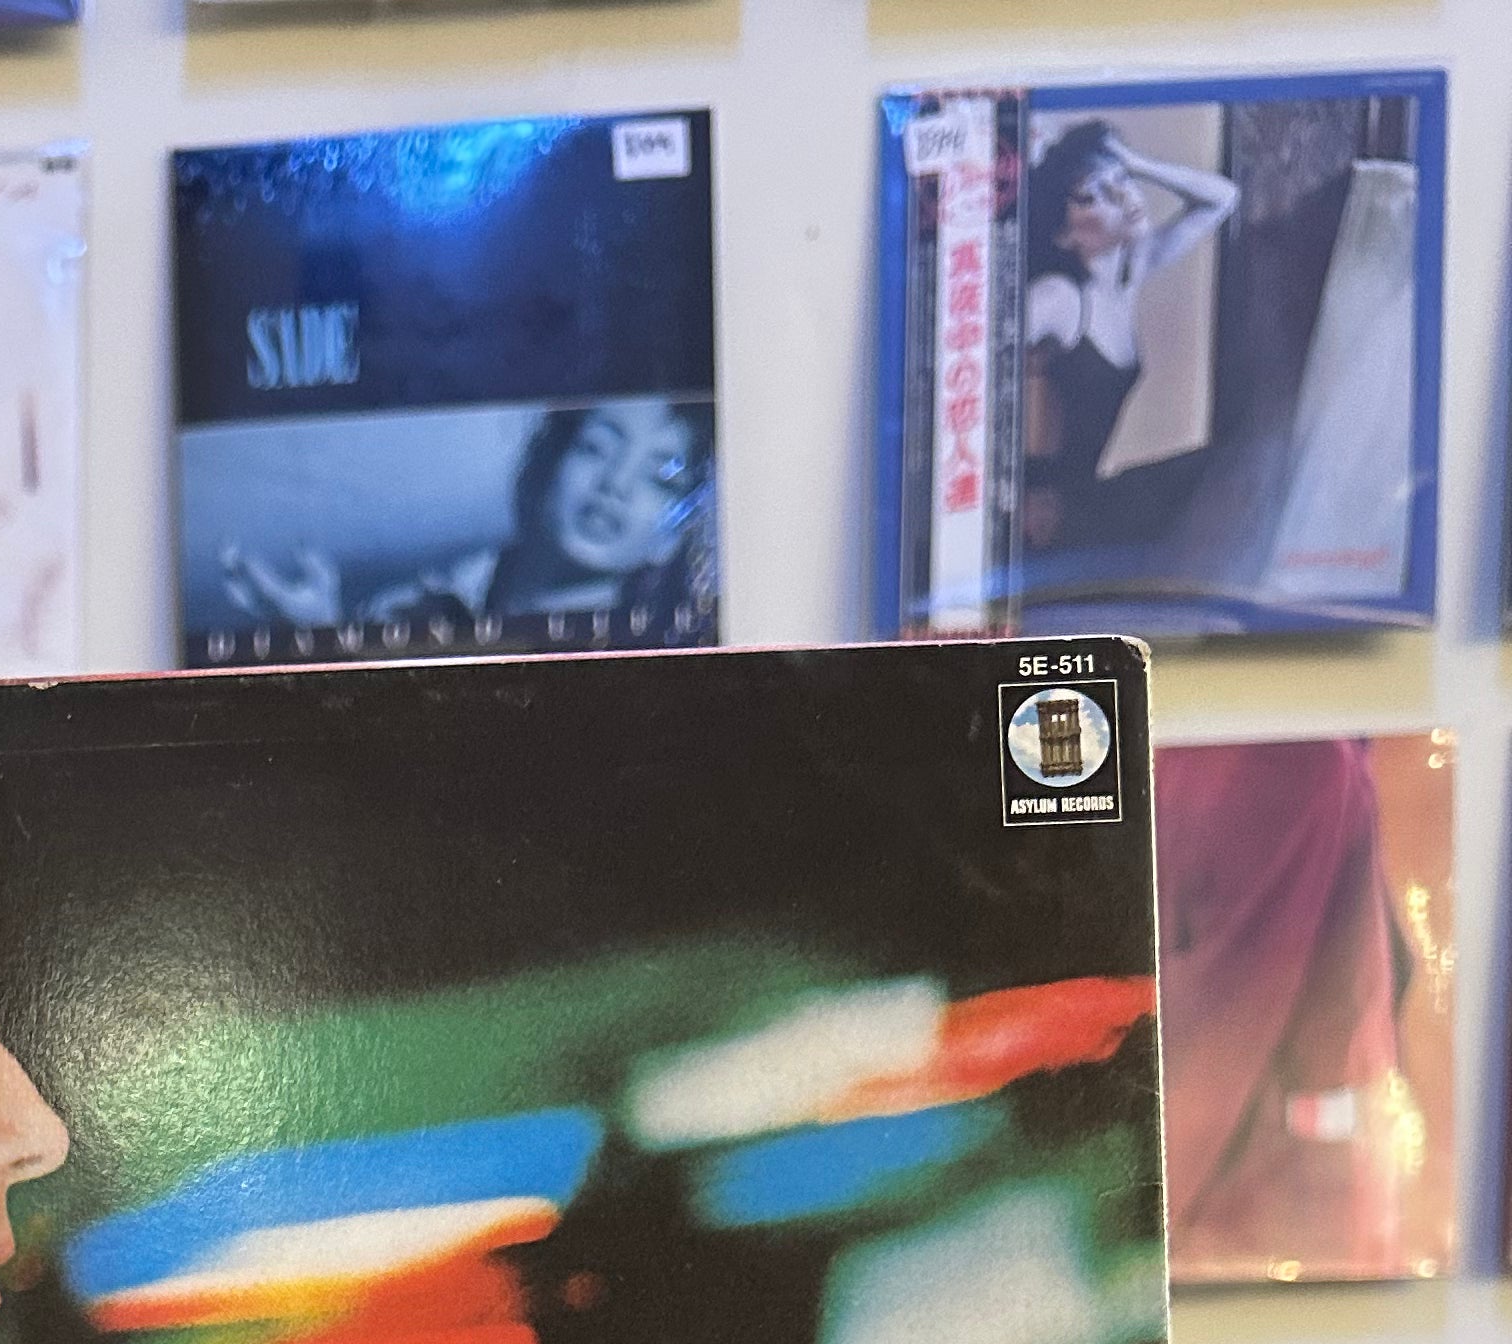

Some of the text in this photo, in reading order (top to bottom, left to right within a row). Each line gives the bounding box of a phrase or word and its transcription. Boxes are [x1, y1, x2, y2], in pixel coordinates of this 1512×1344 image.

[1018, 655, 1095, 677] 5E-511
[1010, 796, 1114, 815] ASYLUM RECORDS
